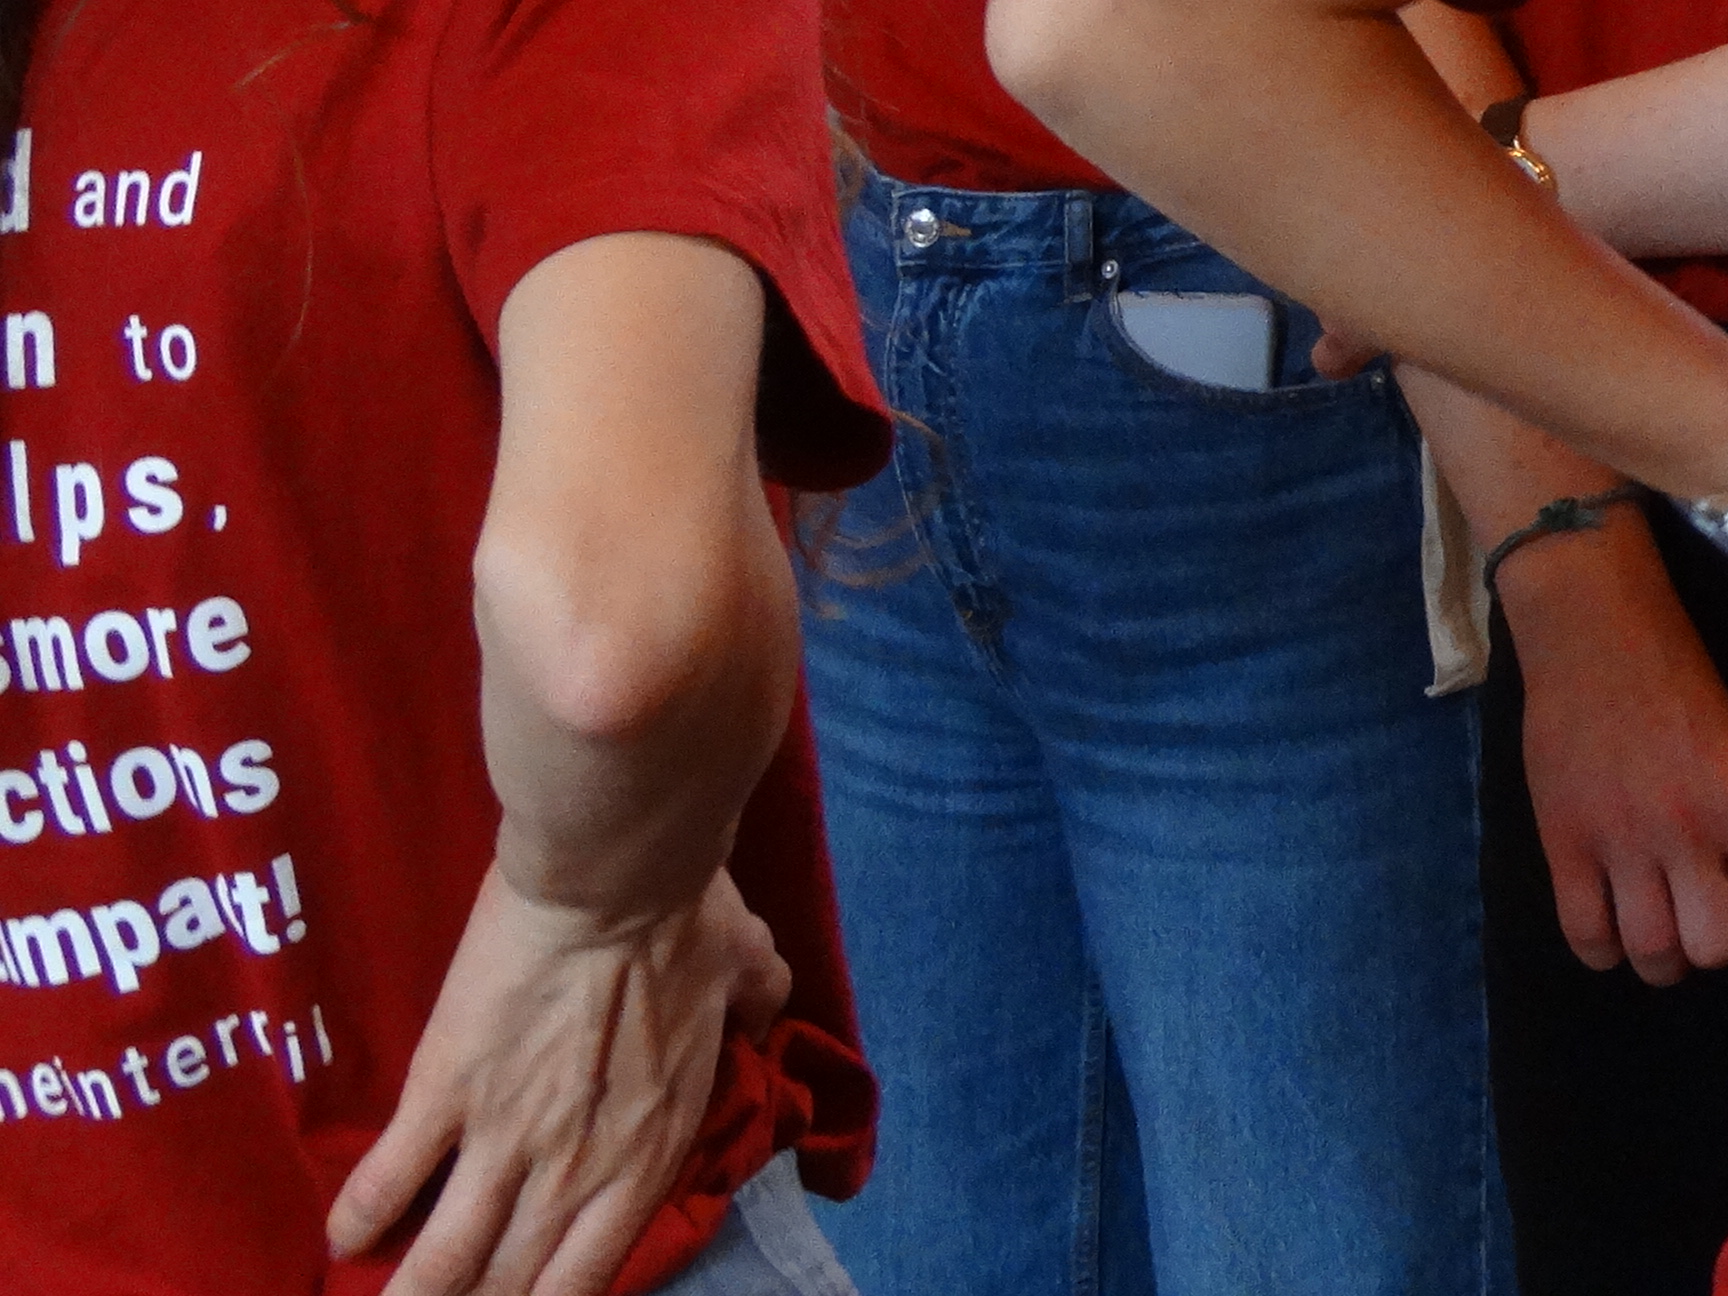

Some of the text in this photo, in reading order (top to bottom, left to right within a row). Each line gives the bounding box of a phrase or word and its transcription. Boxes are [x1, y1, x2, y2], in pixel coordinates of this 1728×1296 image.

[73, 150, 203, 228] and
[124, 315, 197, 382] to
[0, 595, 251, 692] more
